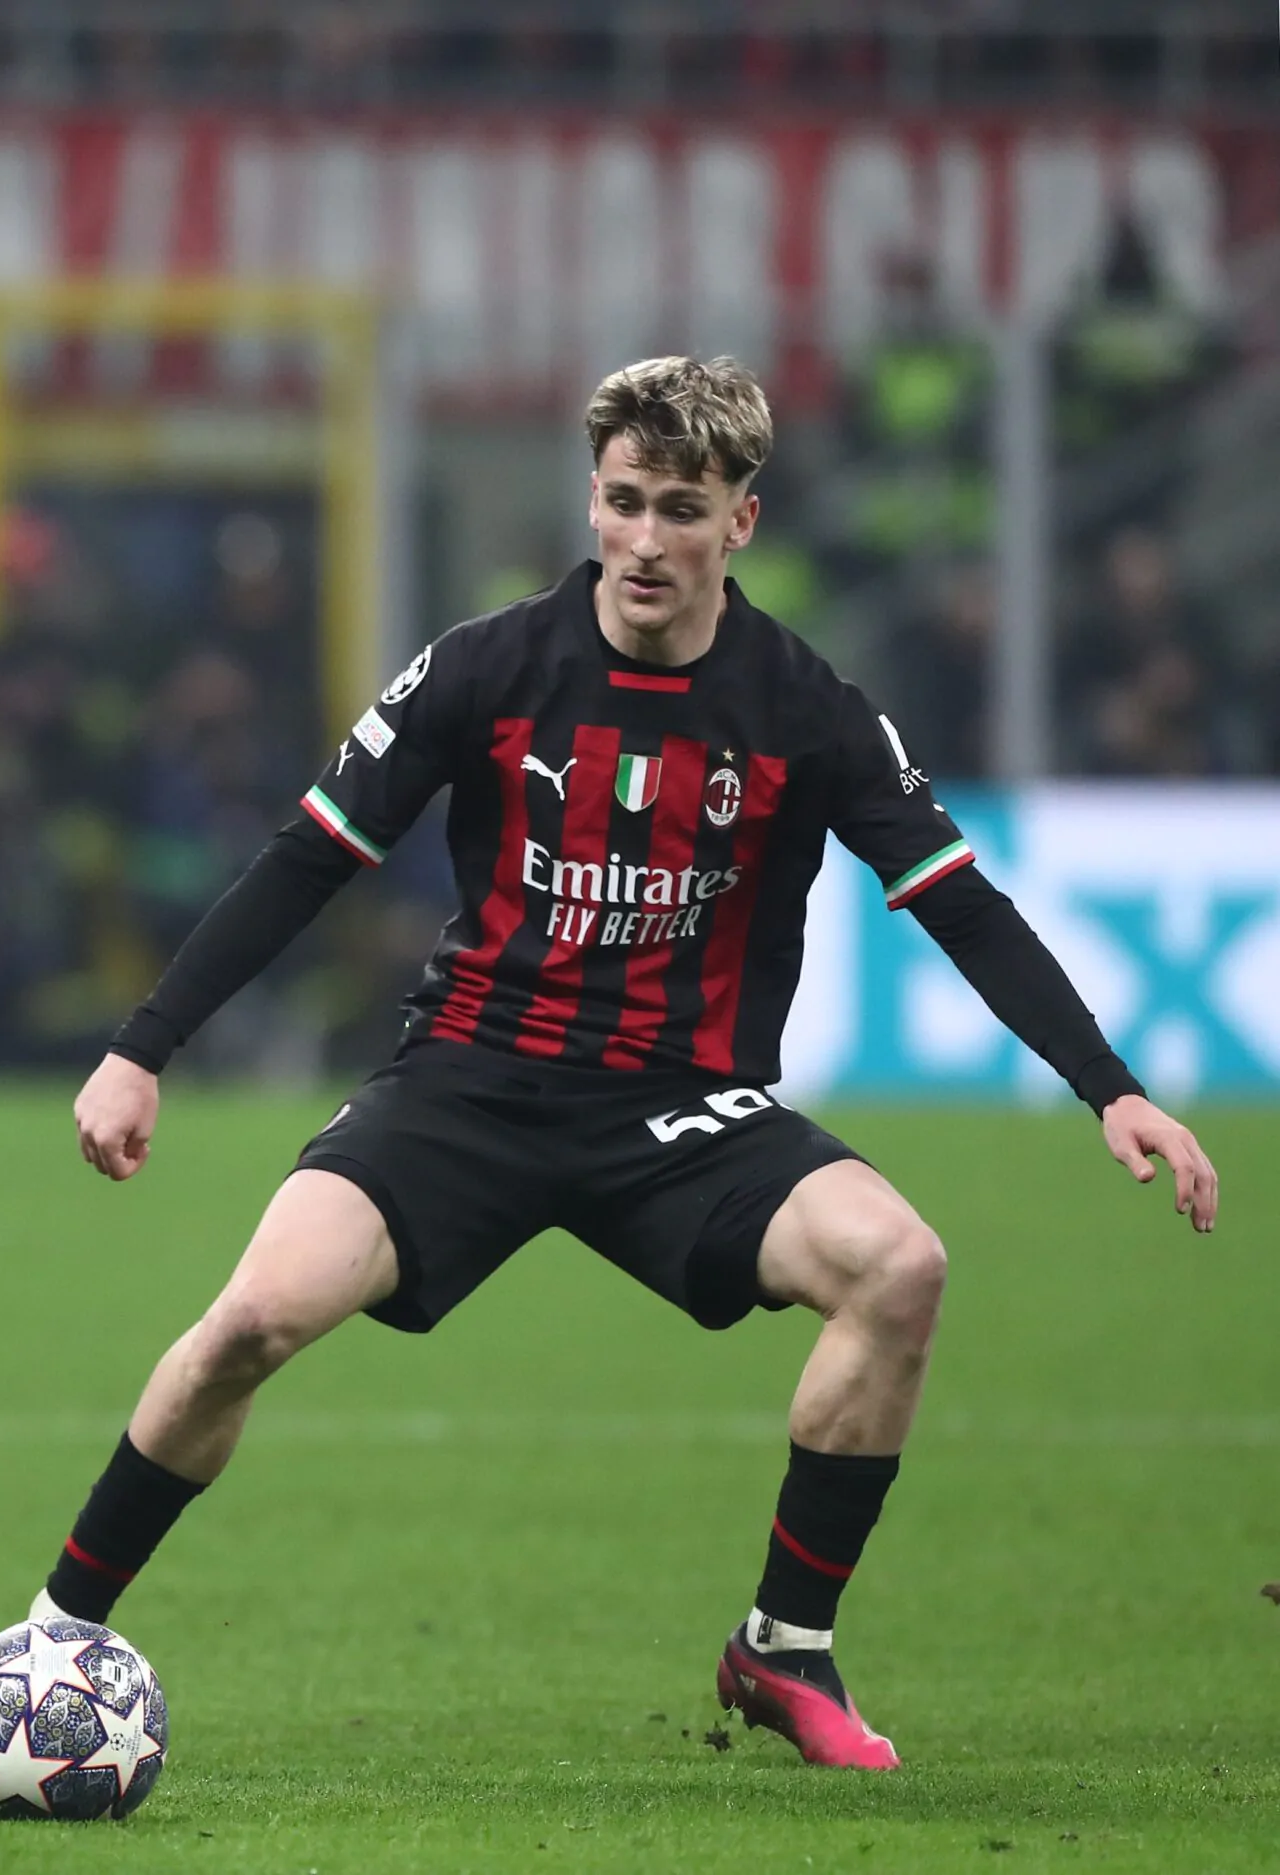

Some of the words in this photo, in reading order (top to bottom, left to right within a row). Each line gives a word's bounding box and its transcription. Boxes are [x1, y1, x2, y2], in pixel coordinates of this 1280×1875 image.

[522, 838, 743, 905] Emirates
[546, 903, 596, 945] FLY
[599, 904, 702, 946] BETTER
